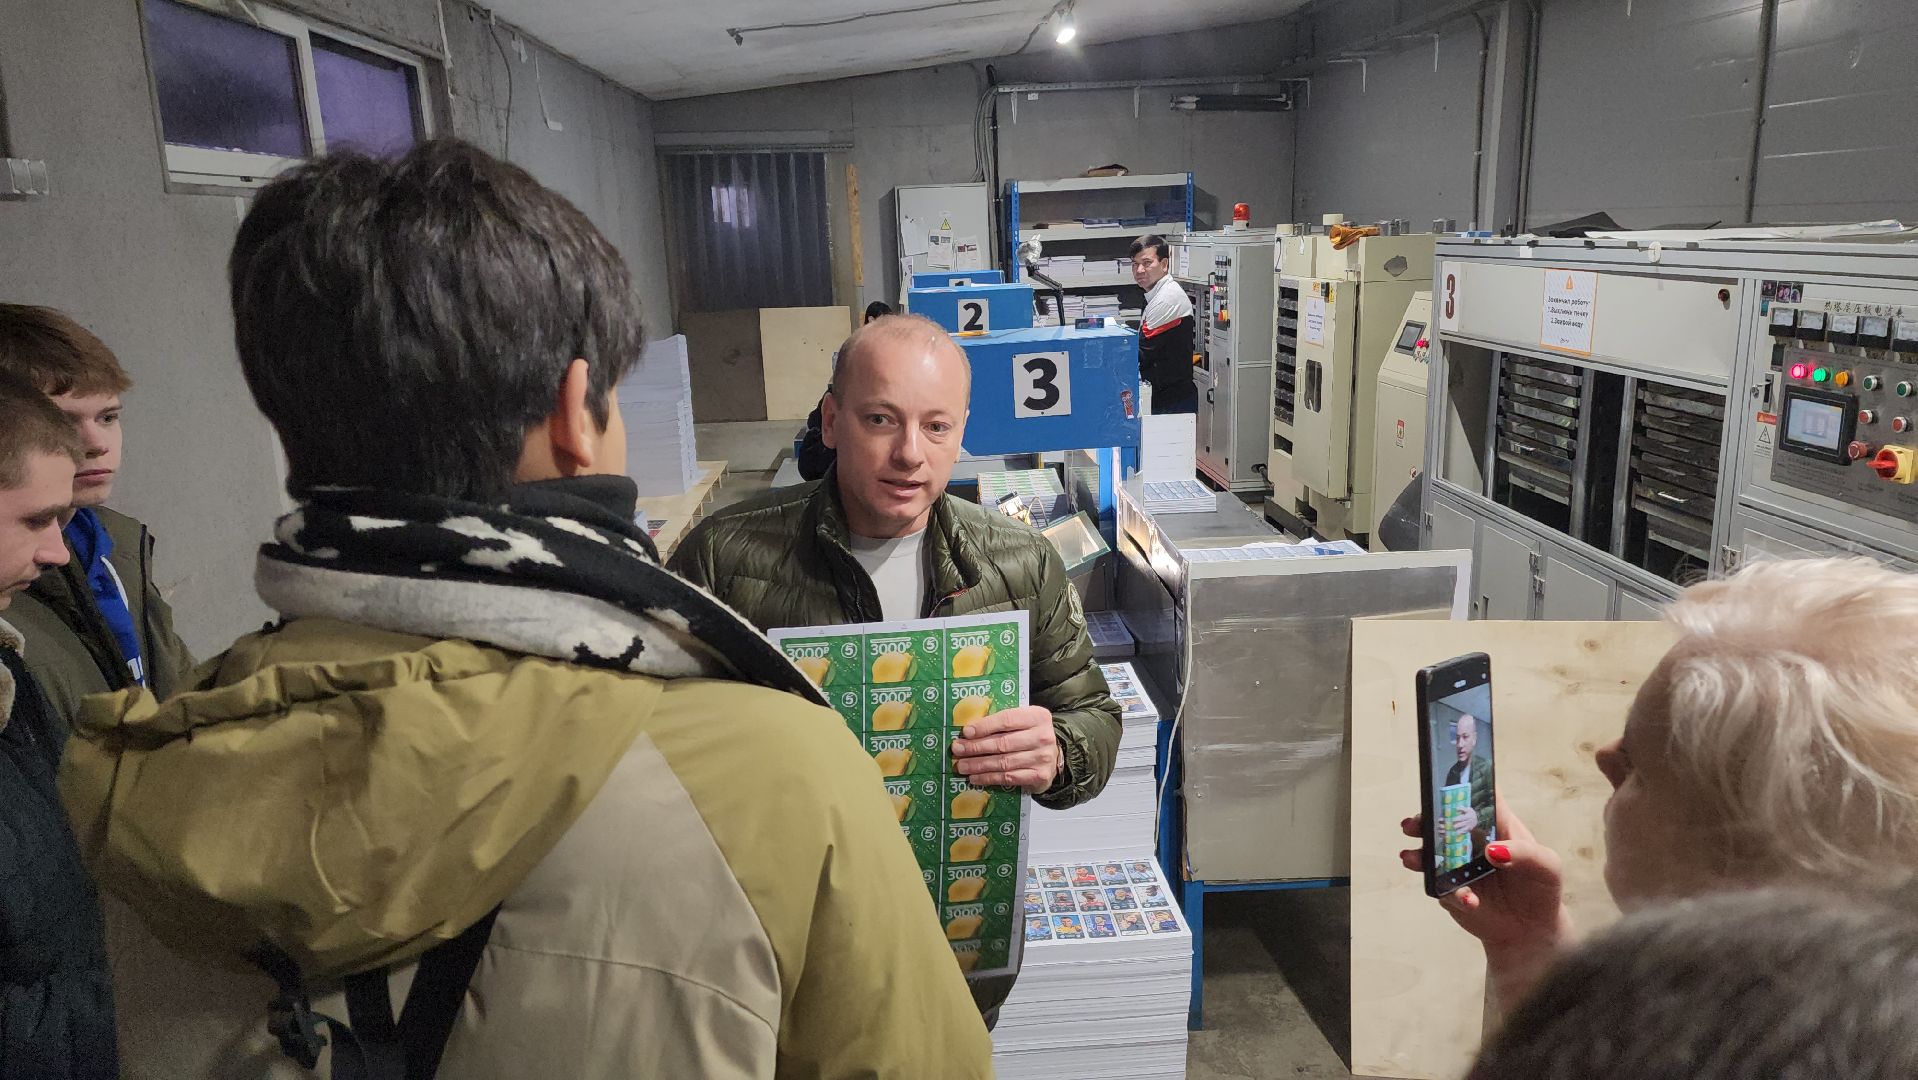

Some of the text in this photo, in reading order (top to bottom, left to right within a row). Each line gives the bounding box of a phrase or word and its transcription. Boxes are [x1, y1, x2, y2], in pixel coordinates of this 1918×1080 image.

[963, 302, 984, 331] 2
[1446, 274, 1455, 319] 3
[1023, 357, 1060, 411] 3
